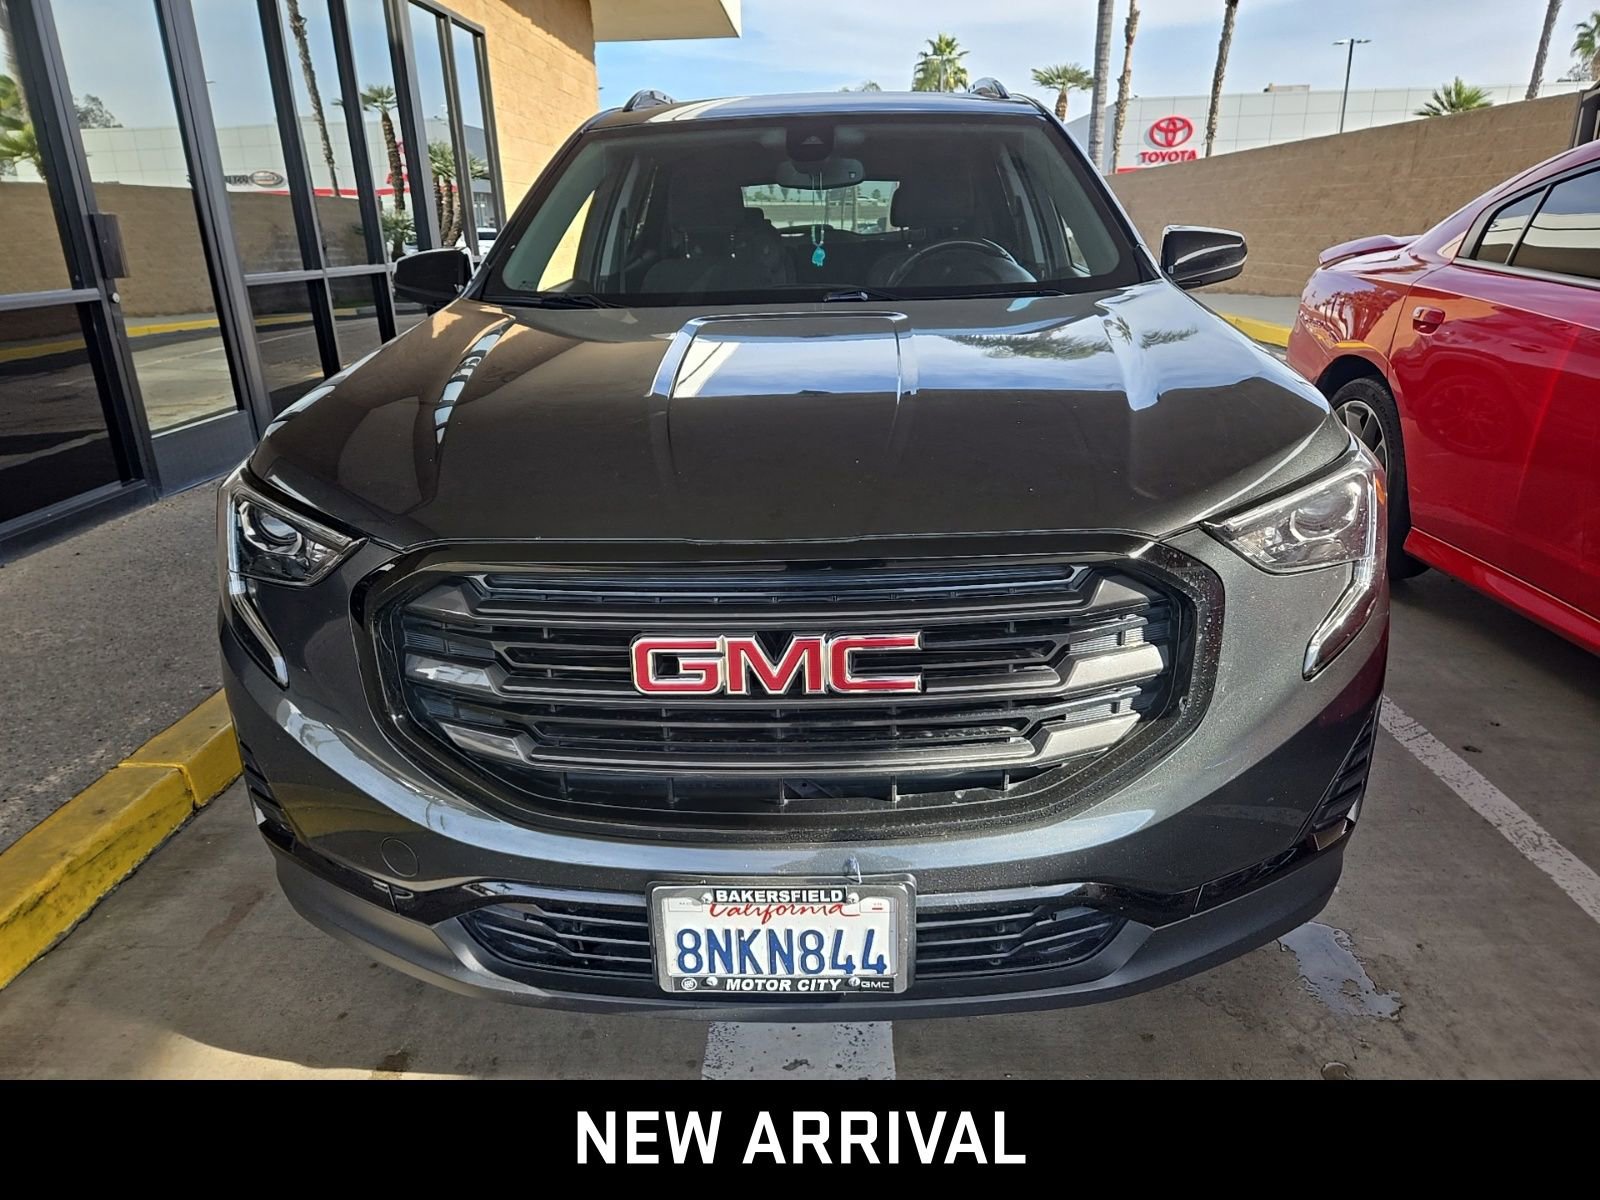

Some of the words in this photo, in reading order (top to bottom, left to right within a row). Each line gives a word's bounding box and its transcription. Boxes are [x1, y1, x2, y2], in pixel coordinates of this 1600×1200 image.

[1141, 150, 1197, 163] TOYOTA
[631, 633, 922, 695] GMC
[715, 889, 843, 902] BAKERSFIELD
[676, 928, 887, 974] 8NKN844
[726, 978, 792, 992] MOTOR
[797, 978, 842, 992] CITY
[861, 981, 890, 989] GMC
